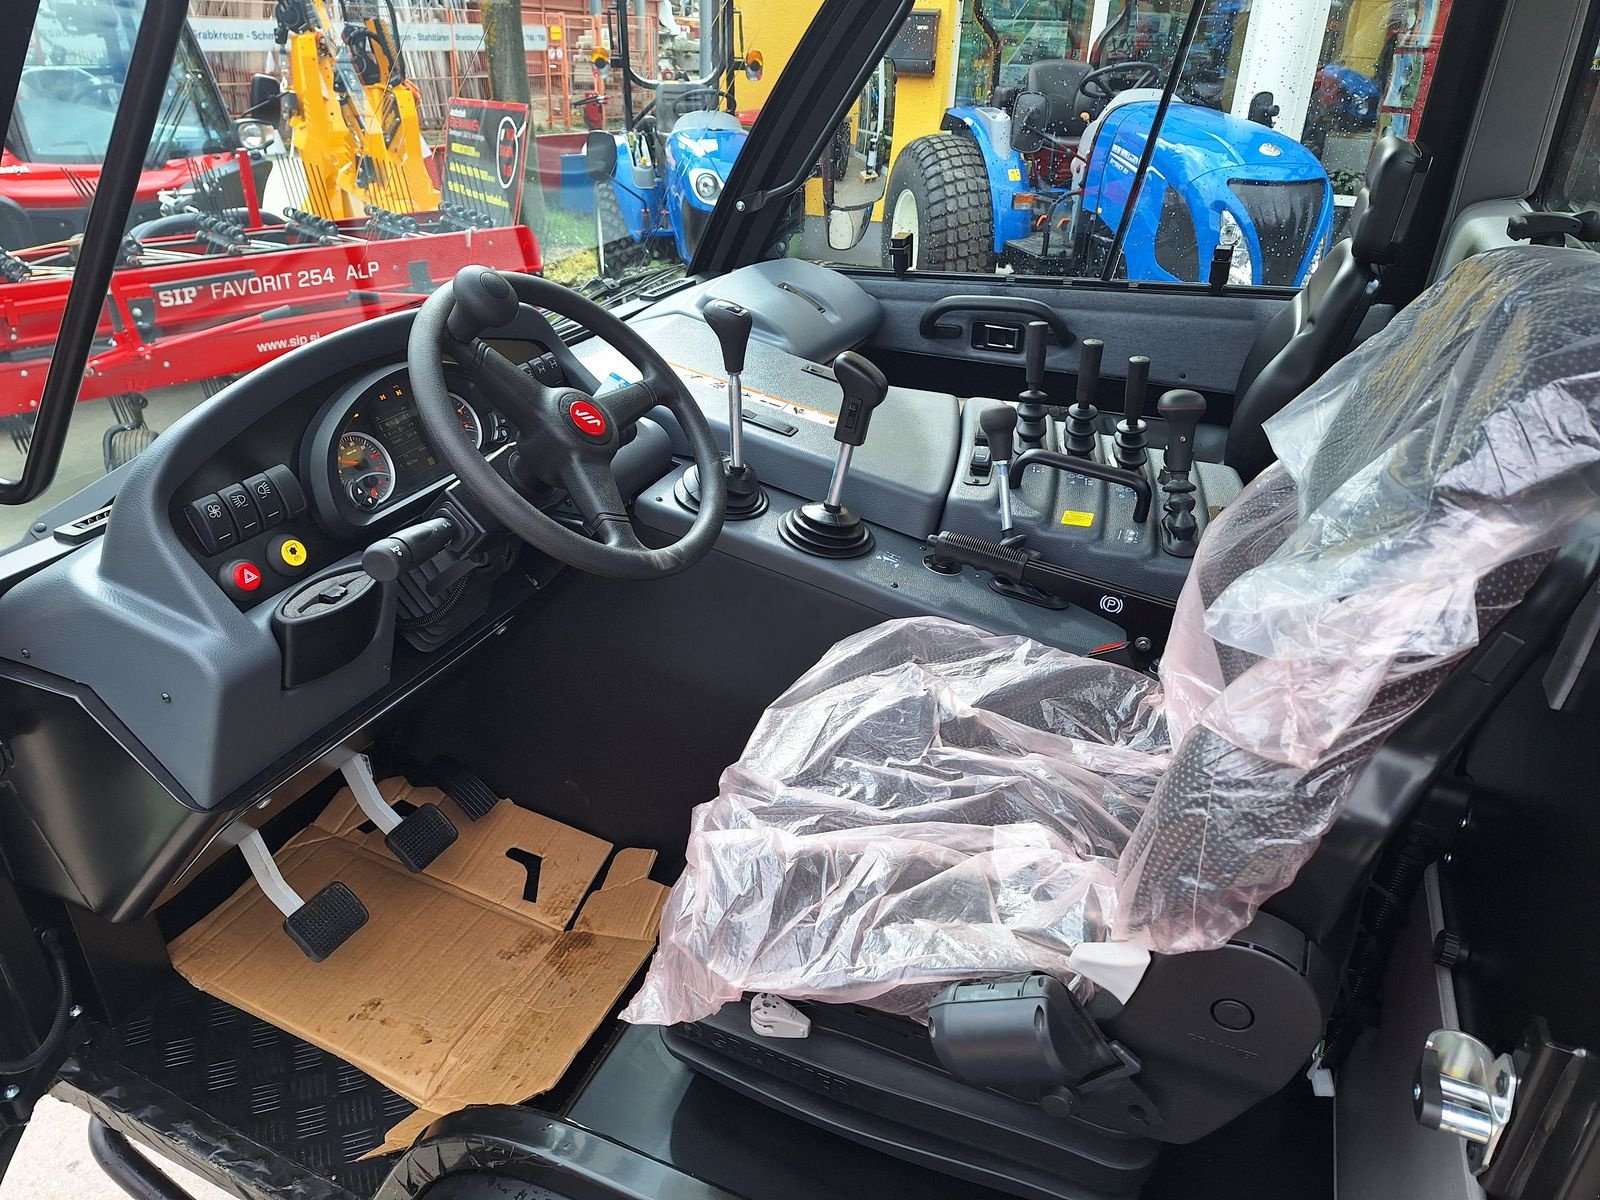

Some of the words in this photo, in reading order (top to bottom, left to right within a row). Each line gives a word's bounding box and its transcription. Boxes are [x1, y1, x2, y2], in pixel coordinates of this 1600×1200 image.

[158, 286, 197, 307] SIP
[211, 273, 292, 299] FAVORIT
[298, 268, 335, 287] 254
[346, 261, 379, 281] ALP
[256, 332, 320, 353] www.sipsi
